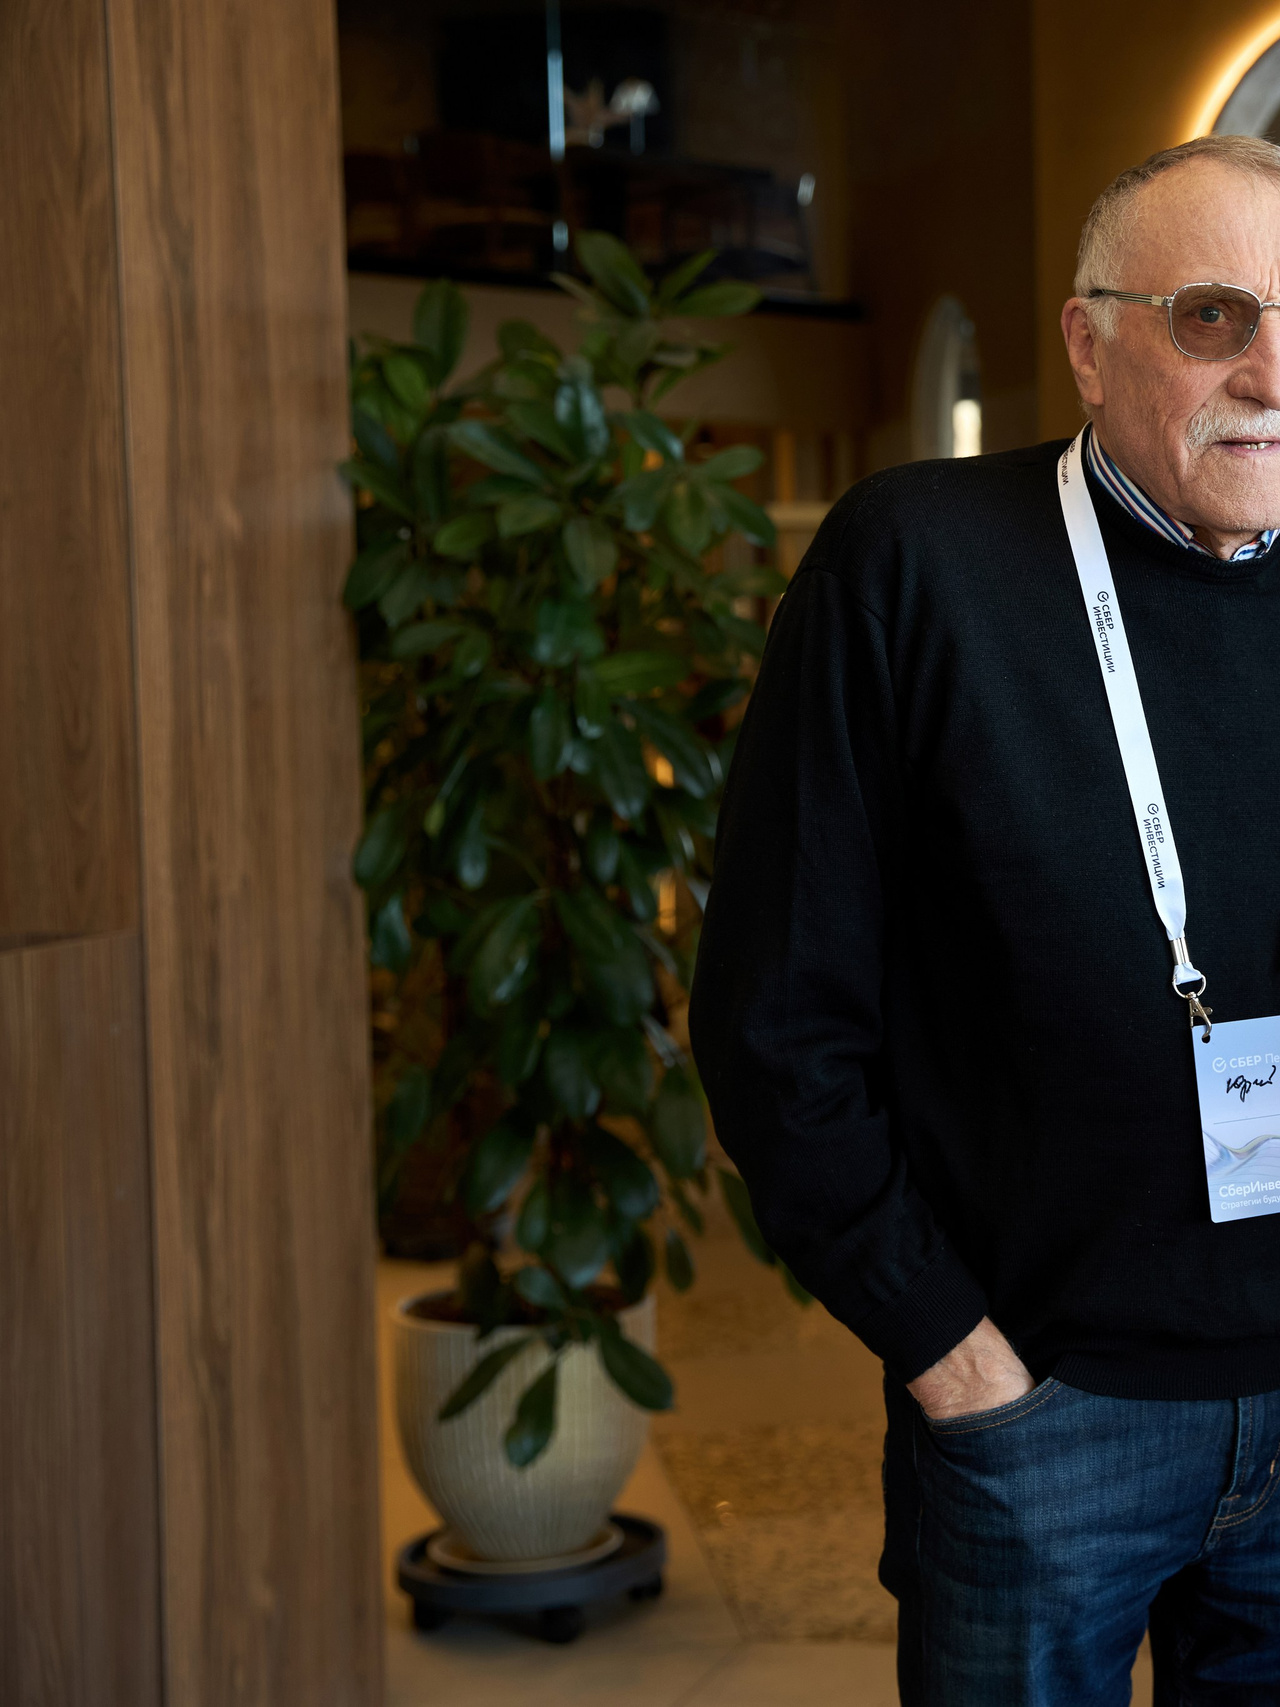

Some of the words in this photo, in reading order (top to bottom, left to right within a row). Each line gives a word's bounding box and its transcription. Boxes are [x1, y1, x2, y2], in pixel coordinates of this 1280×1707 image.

[1102, 604, 1115, 630] СБЕР
[1093, 606, 1116, 674] ИНВЕСТИЦИИ
[1152, 817, 1165, 844] СБЕР
[1143, 818, 1166, 889] ИНВЕСТИЦИИ
[1229, 1055, 1262, 1069] СБЕР
[1220, 1197, 1261, 1210] Стратегии
